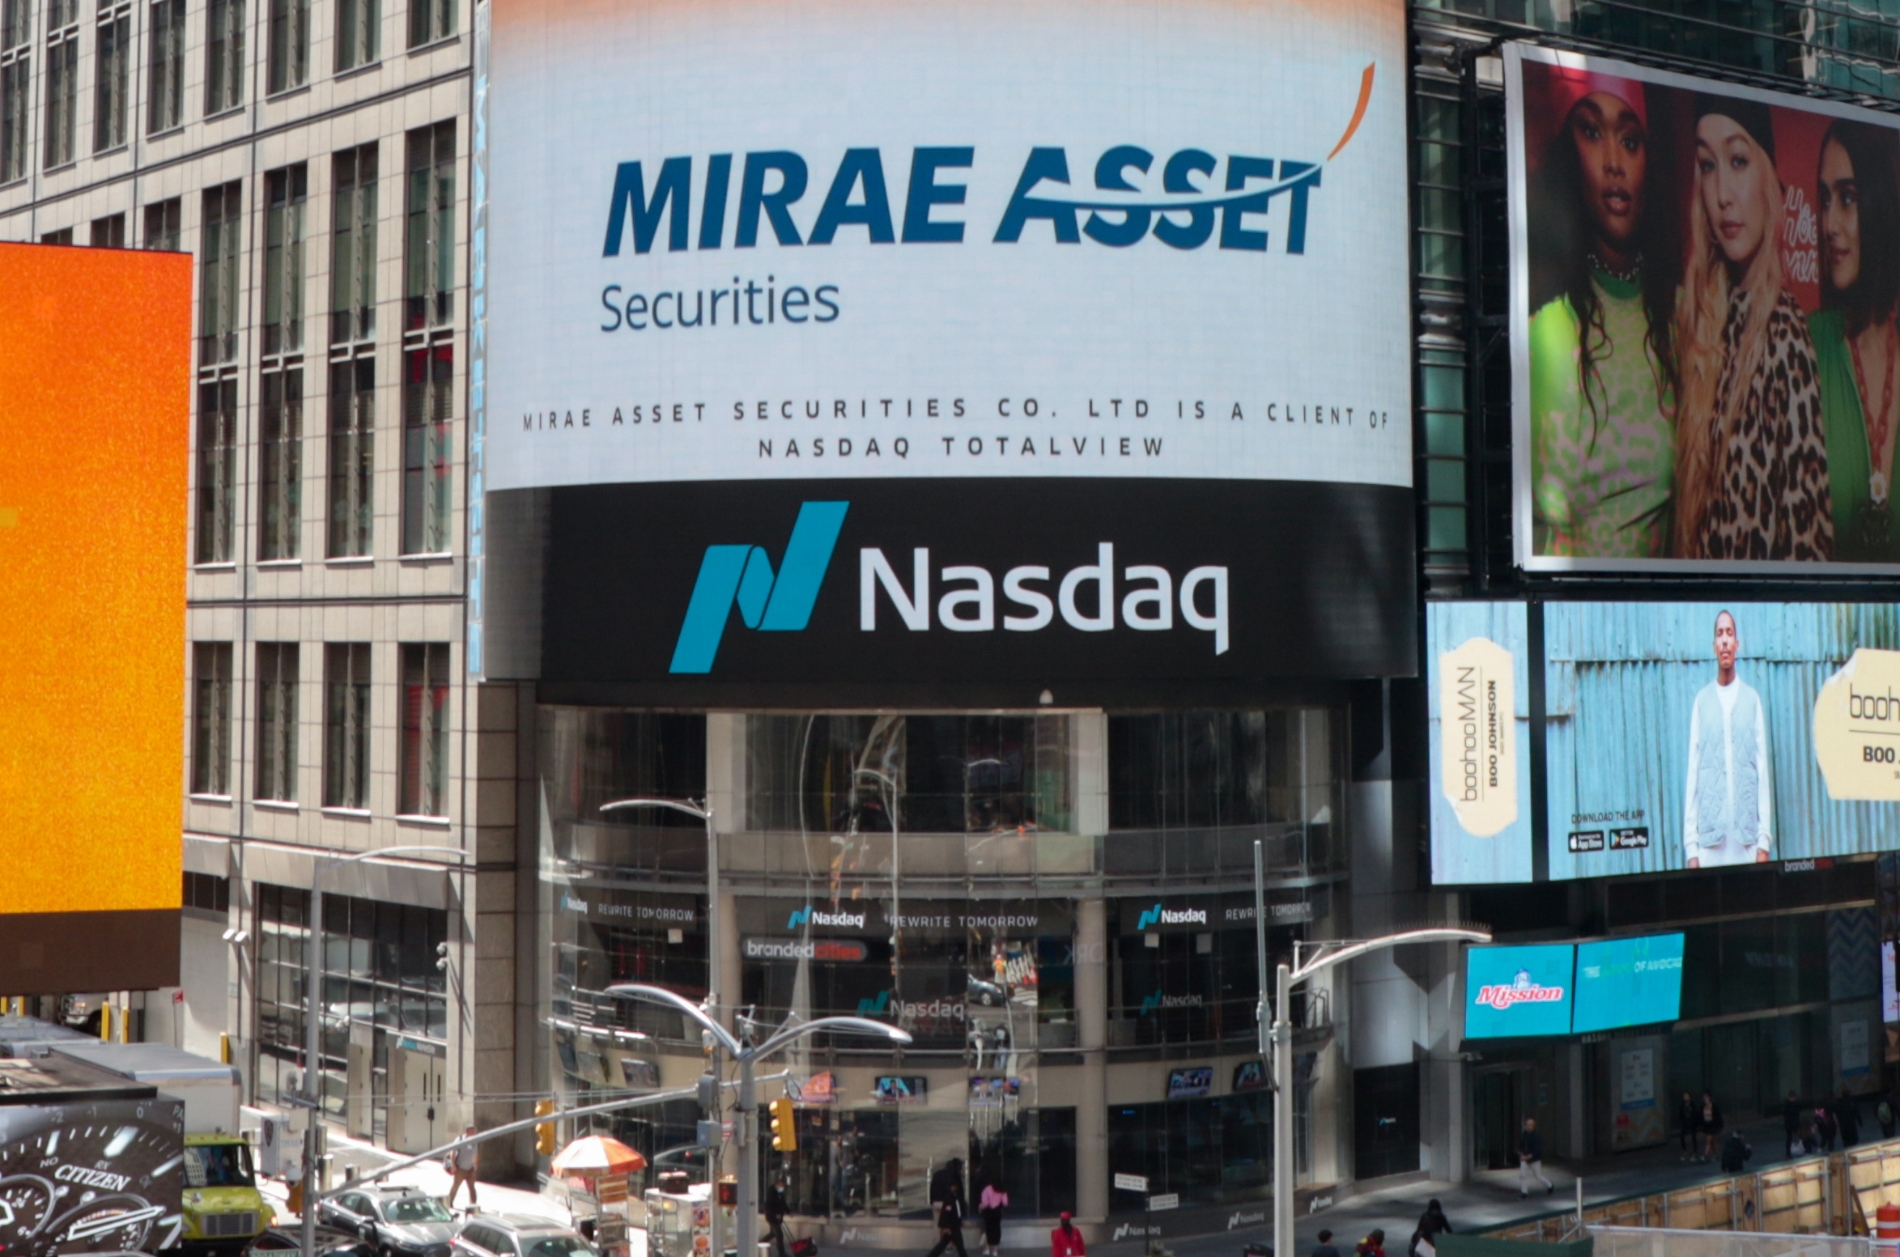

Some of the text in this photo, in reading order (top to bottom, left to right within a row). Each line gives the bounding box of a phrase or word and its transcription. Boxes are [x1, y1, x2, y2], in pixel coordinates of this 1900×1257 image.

[602, 144, 1323, 258] MIRAE ASSET
[600, 275, 840, 332] Securities
[523, 398, 1388, 431] MIRAE ASSET SECURITIES CO. LTD IS A CLIENT OF
[758, 436, 1164, 459] NASDAQ TOTALVIEW
[859, 542, 1230, 655] Nasdaq
[1850, 682, 1900, 721] booh
[1456, 666, 1478, 802] boohooMAN
[1487, 680, 1498, 788] BOO JOHNSON
[1863, 746, 1896, 764] BOO
[1571, 809, 1645, 824] DOWNLOAD THE APP
[566, 897, 694, 921] Nasdaq REWRITE TOMORROW
[812, 911, 1039, 928] Nasdaq REWRITE TOMORROW
[1161, 909, 1207, 925] Nasdaq
[1226, 906, 1267, 921] REWRIE
[890, 1000, 965, 1020] Nasdaq
[1162, 994, 1202, 1008] Nasdaq
[1476, 983, 1563, 1010] Mission
[54, 1164, 131, 1192] CITIZEN
